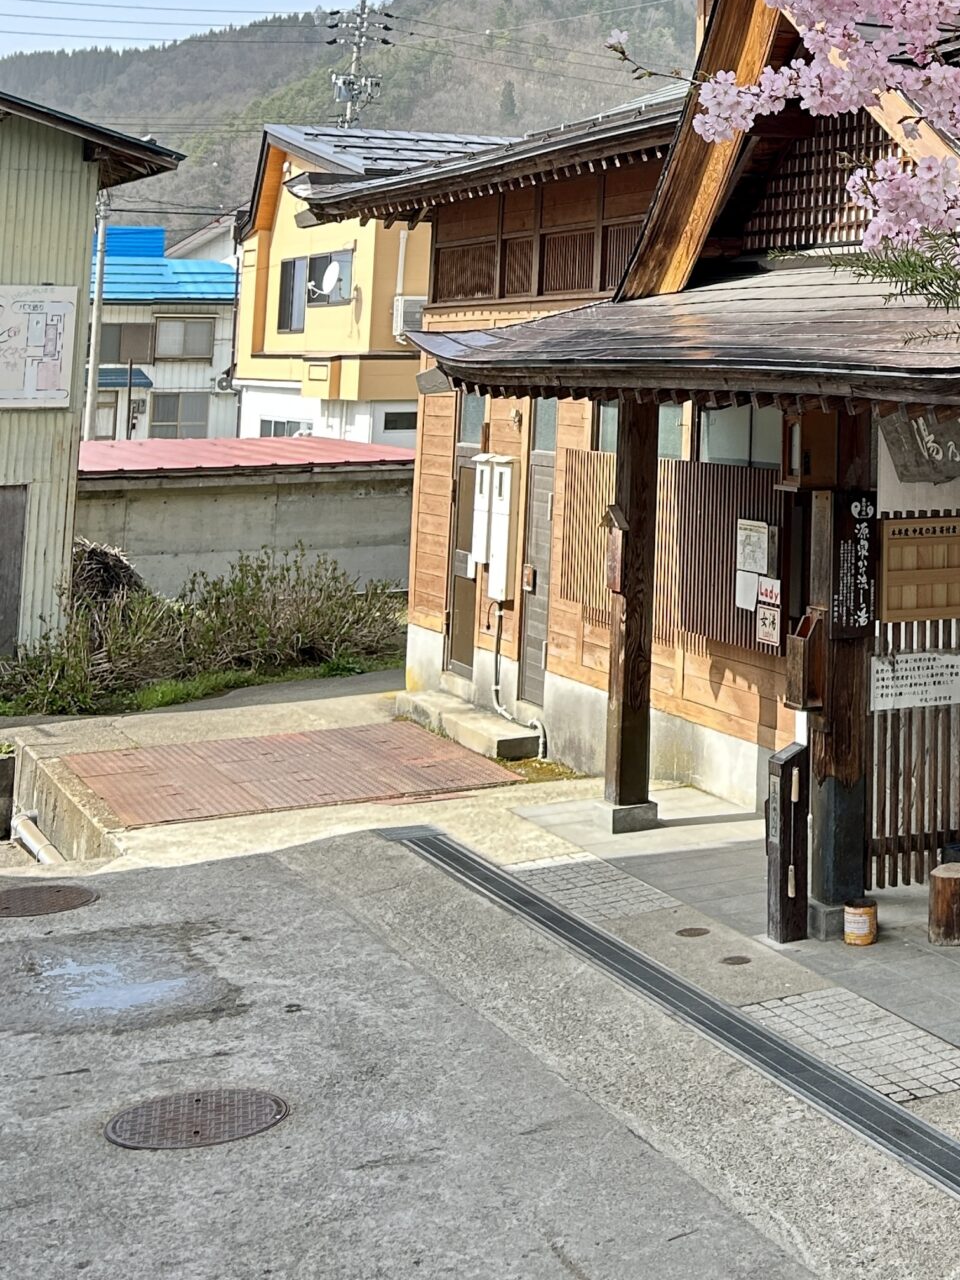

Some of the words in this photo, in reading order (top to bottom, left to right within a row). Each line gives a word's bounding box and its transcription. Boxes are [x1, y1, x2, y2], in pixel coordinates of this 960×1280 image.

[912, 526, 937, 537] 中尾の湯
[760, 581, 779, 602] Lady
[760, 610, 776, 631] 女湯
